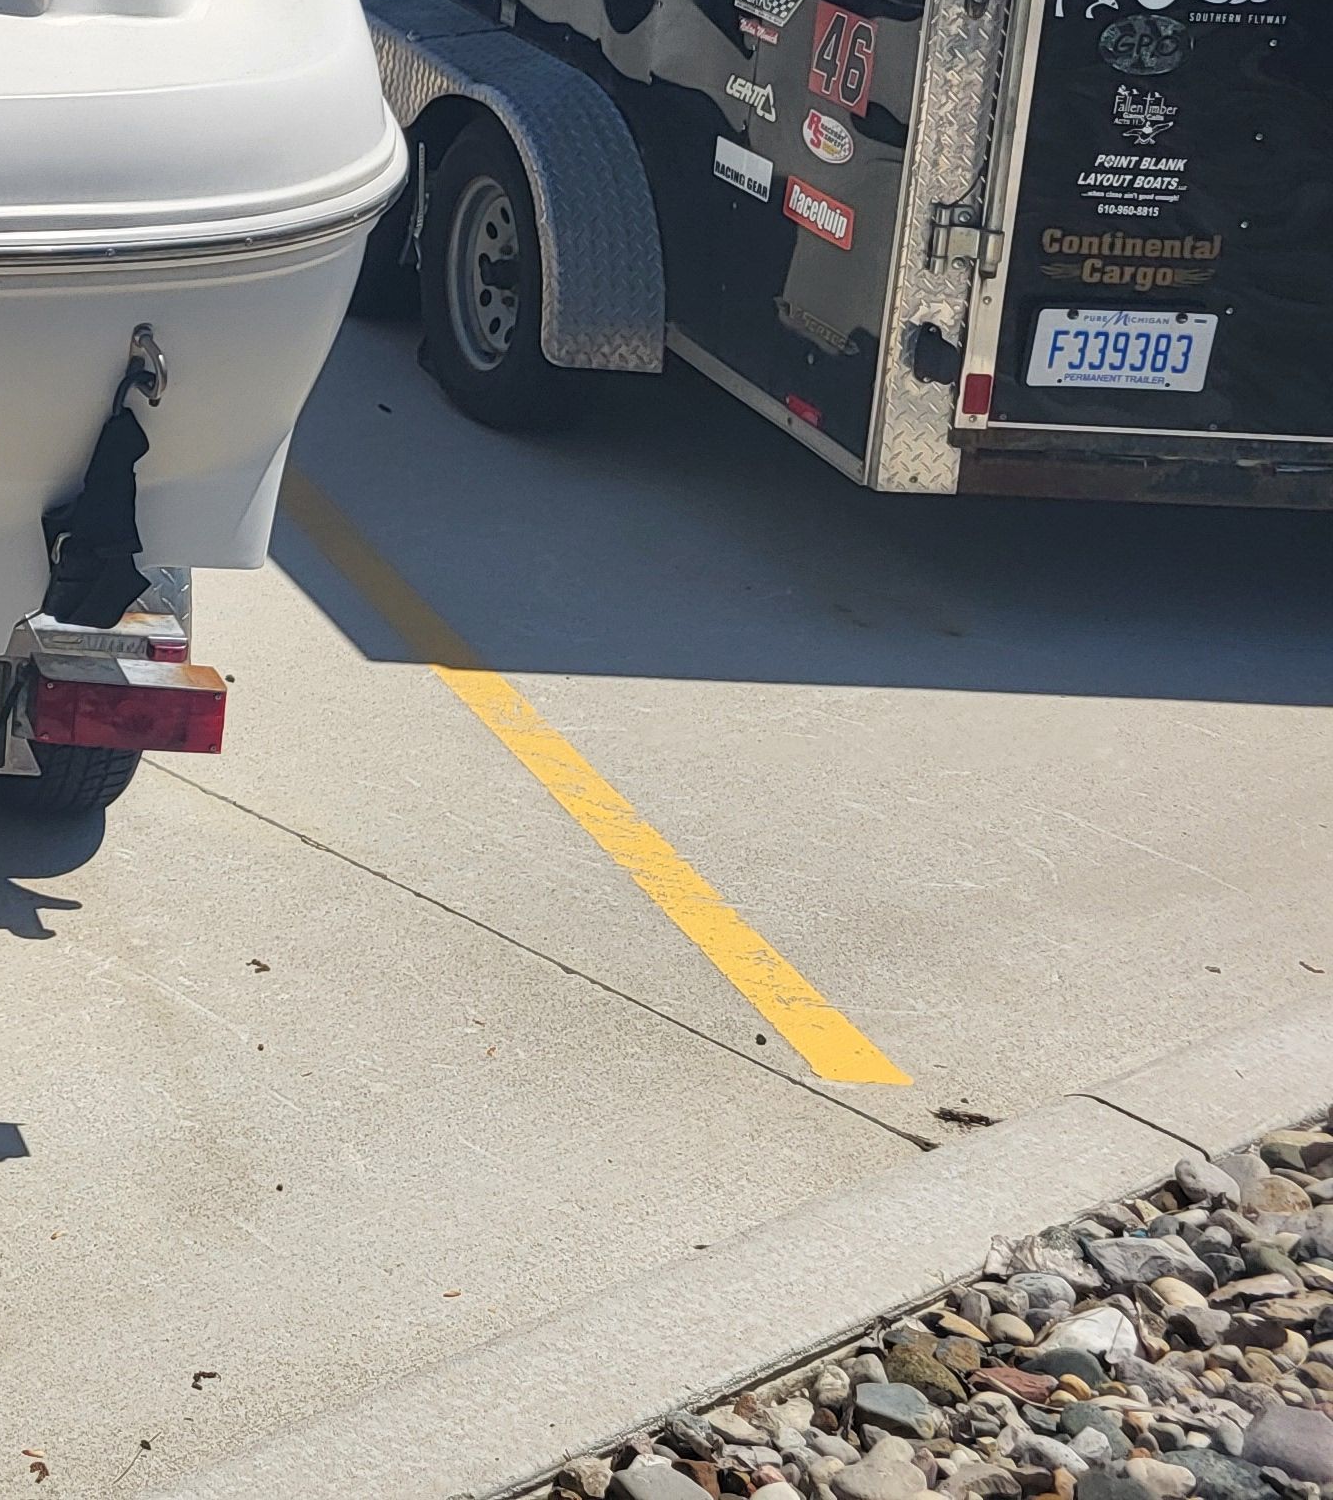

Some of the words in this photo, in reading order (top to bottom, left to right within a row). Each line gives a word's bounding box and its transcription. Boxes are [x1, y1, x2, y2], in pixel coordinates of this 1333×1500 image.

[1189, 12, 1242, 23] SOUTHERN
[1248, 14, 1287, 25] FLYWAY
[812, 11, 875, 107] 46
[1112, 94, 1143, 115] Fallen
[1143, 92, 1179, 116] Timber
[1095, 154, 1139, 169] POINT
[1139, 157, 1187, 172] BLANK
[714, 159, 746, 187] RACING
[746, 177, 768, 199] GEAR
[1077, 172, 1133, 188] LAYOUT
[1133, 176, 1179, 190] BOATS
[788, 184, 848, 239] RaceQuip
[1041, 227, 1222, 260] Continental
[1080, 257, 1176, 292] Cargo
[1083, 314, 1108, 323] PURE
[1103, 310, 1170, 328] MICHIGAN
[1047, 329, 1194, 374] F339383
[1063, 373, 1123, 384] PERMANENT
[1125, 375, 1166, 385] TRAILER
